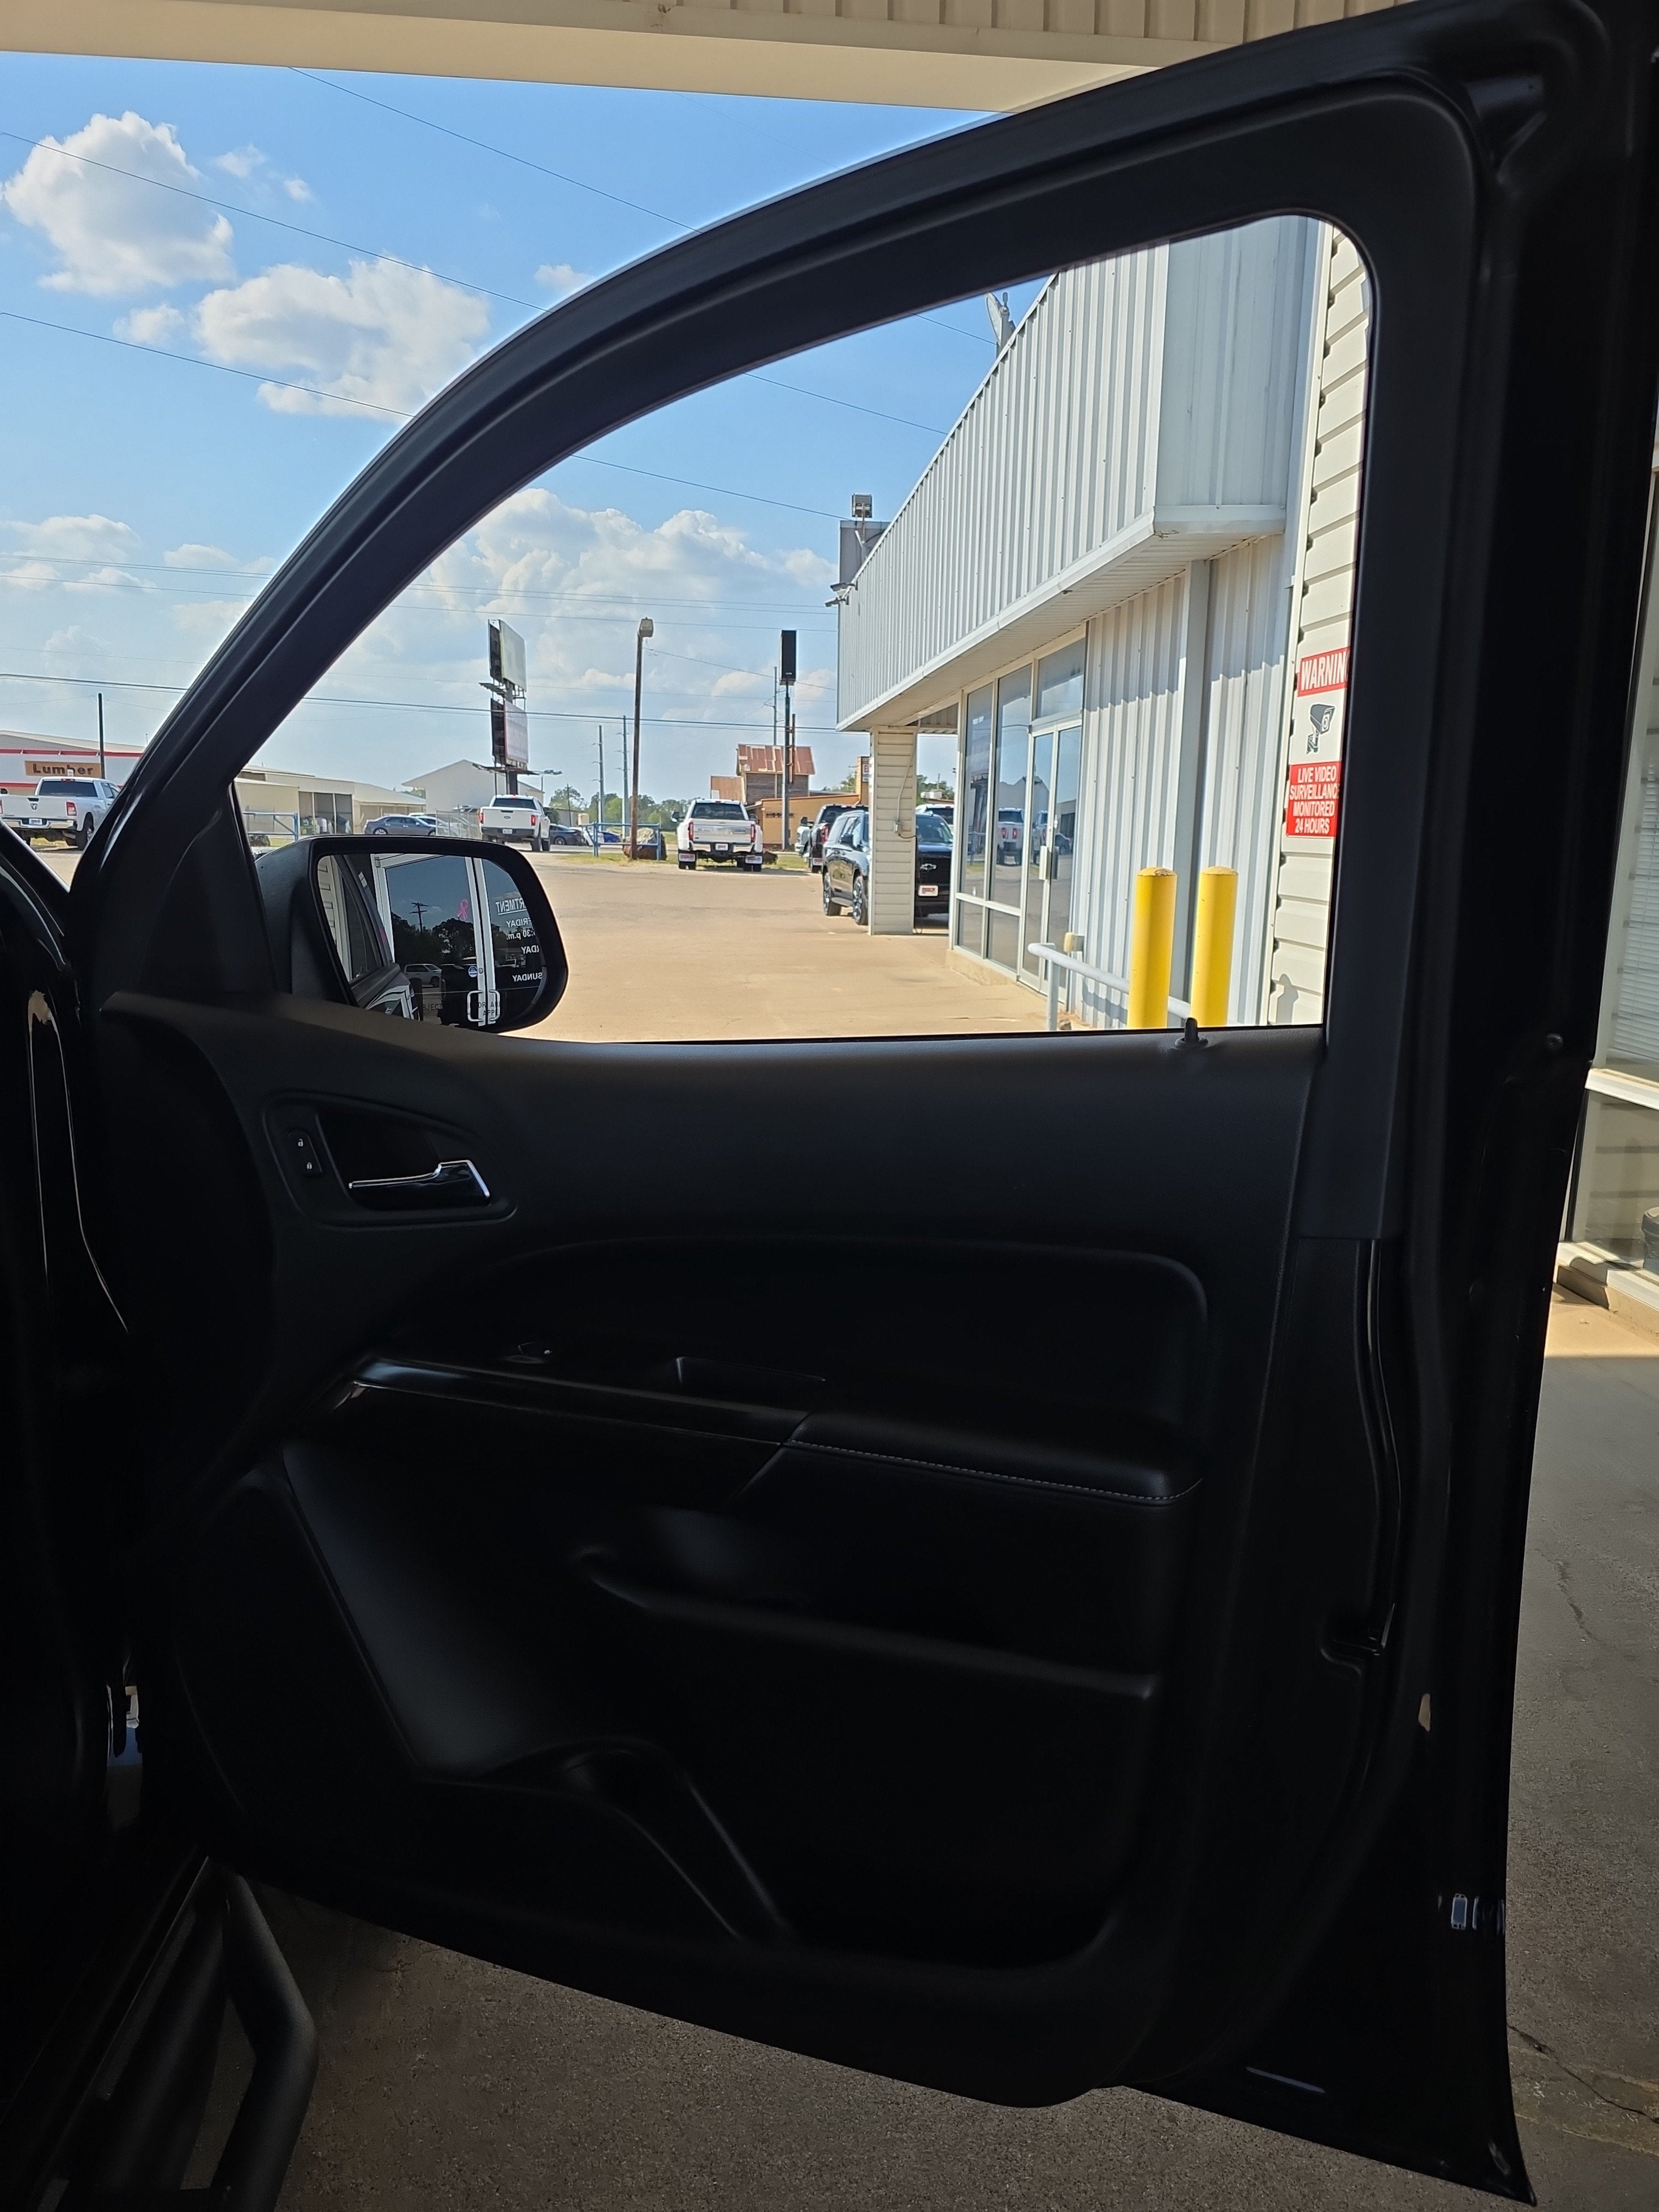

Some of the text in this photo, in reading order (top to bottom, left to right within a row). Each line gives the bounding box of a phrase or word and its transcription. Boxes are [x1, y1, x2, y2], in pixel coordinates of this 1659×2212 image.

[1297, 765, 1337, 783] LIVE VIDEO
[1293, 800, 1335, 817] MONITORED
[1295, 818, 1330, 834] 24 HOURS
